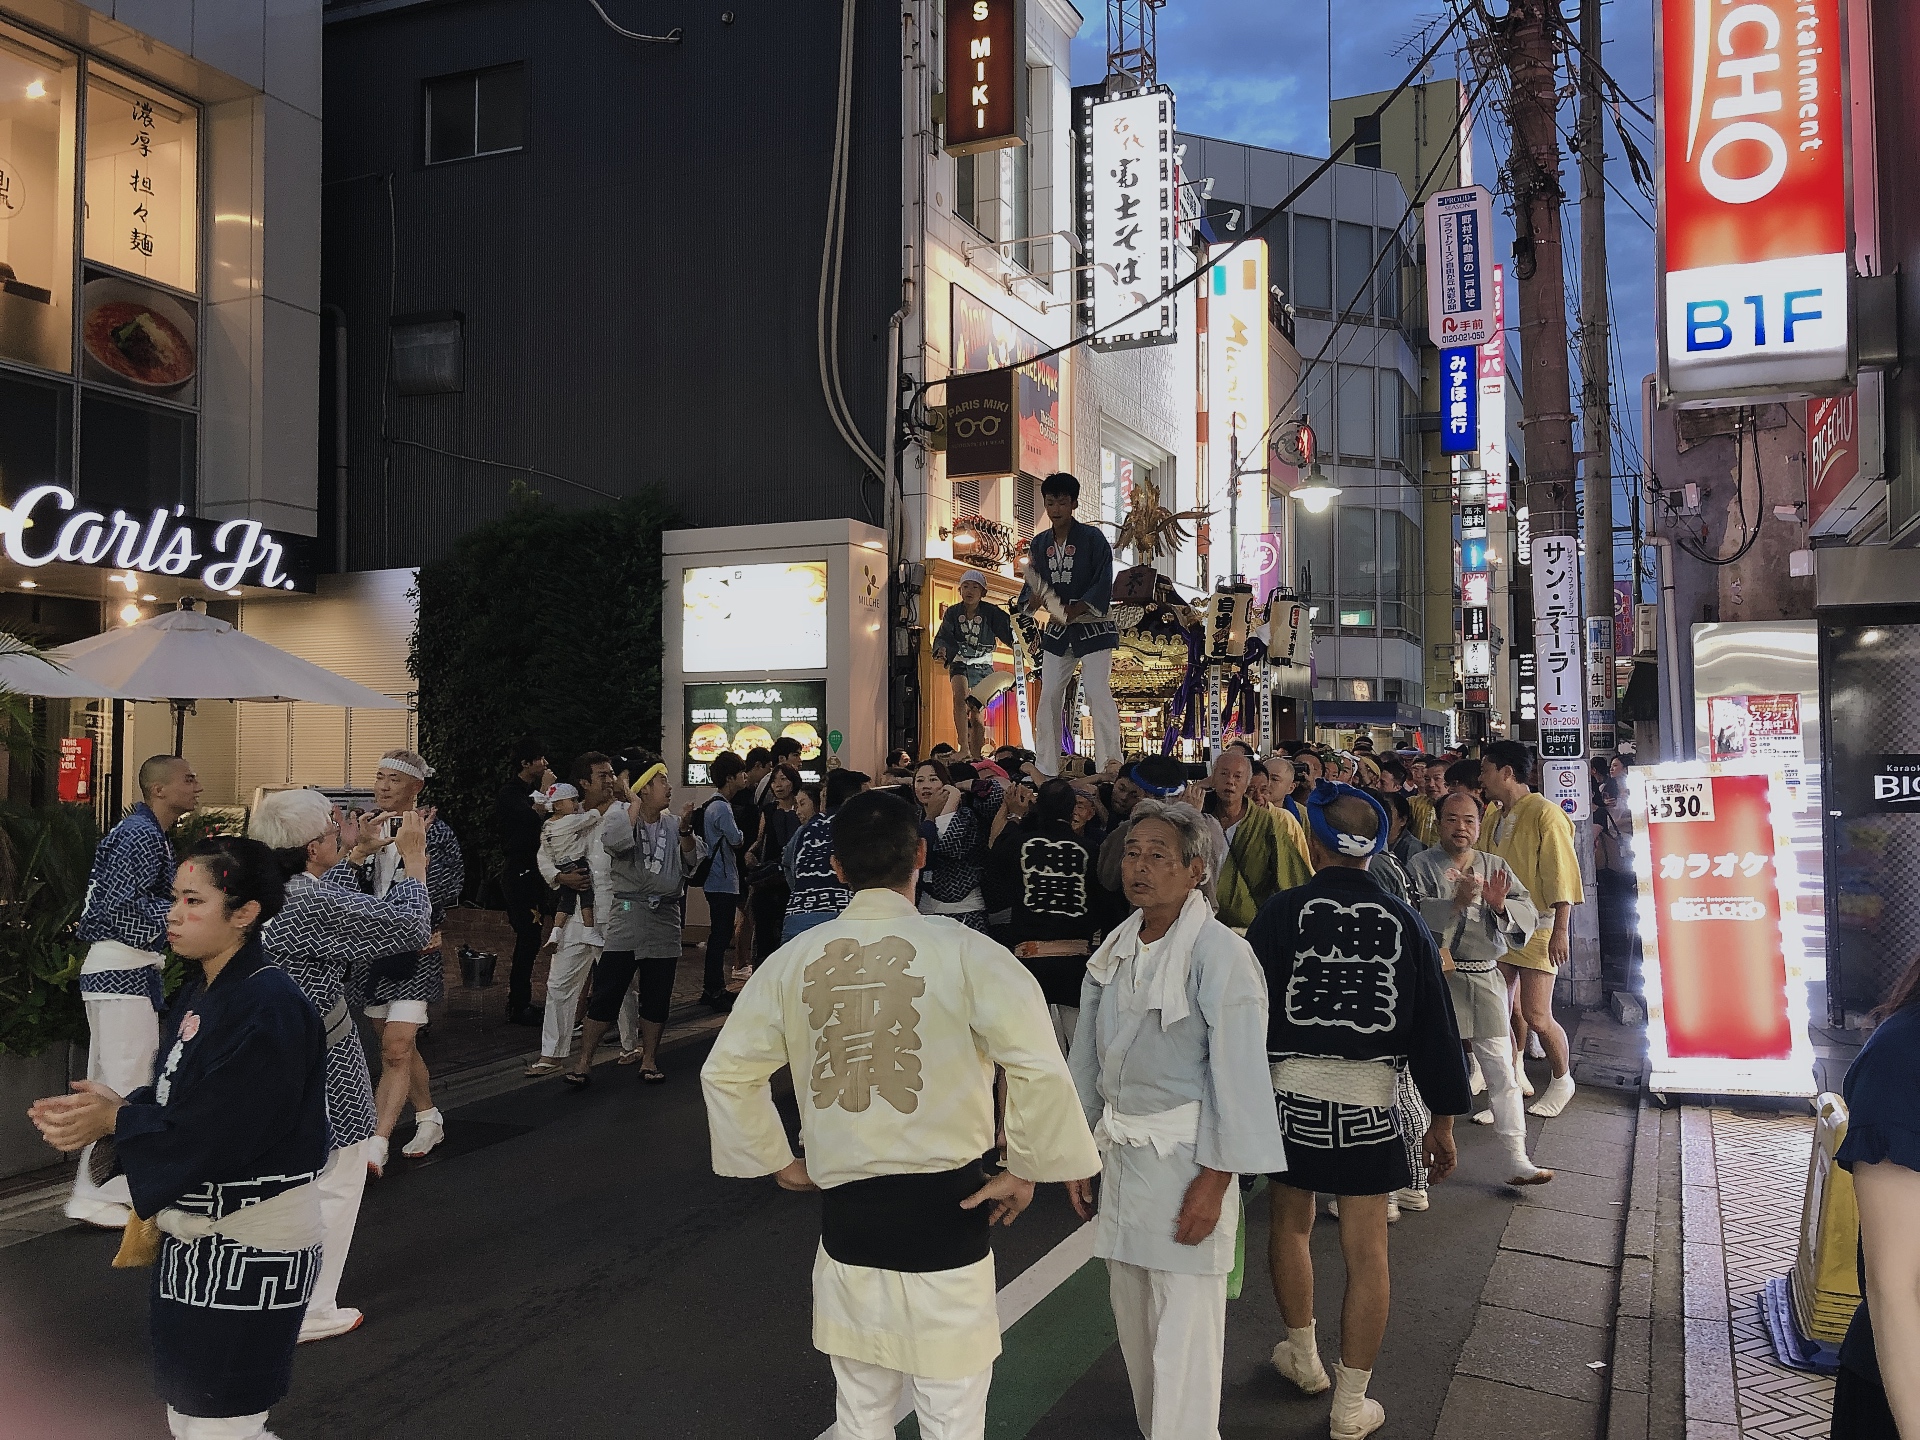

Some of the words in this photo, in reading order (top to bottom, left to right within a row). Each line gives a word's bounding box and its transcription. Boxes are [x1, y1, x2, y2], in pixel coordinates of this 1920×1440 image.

[970, 37, 991, 129] MIKI
[1700, 0, 1788, 204] CHO
[1444, 194, 1471, 204] PROUD
[1444, 202, 1470, 212] SEASON
[1460, 319, 1484, 331] 手前
[1685, 288, 1823, 352] B1F
[1442, 331, 1485, 344] 0120-021-050
[1450, 355, 1468, 434] みずほ銀行
[947, 399, 981, 419] PARIS
[983, 398, 1010, 413] MIKI
[1812, 425, 1828, 490] BIG
[1463, 515, 1485, 527] 歯科
[2, 485, 203, 577] Carl's
[204, 519, 296, 592] Jr.
[858, 595, 881, 609] MILCHE
[1591, 651, 1605, 708] 長生院
[1559, 704, 1578, 712] ここ
[1541, 717, 1580, 726] 3718-2050
[1546, 734, 1576, 743] 自由が丘
[1548, 745, 1574, 754] 2-11
[1660, 851, 1769, 880] カラオケ
